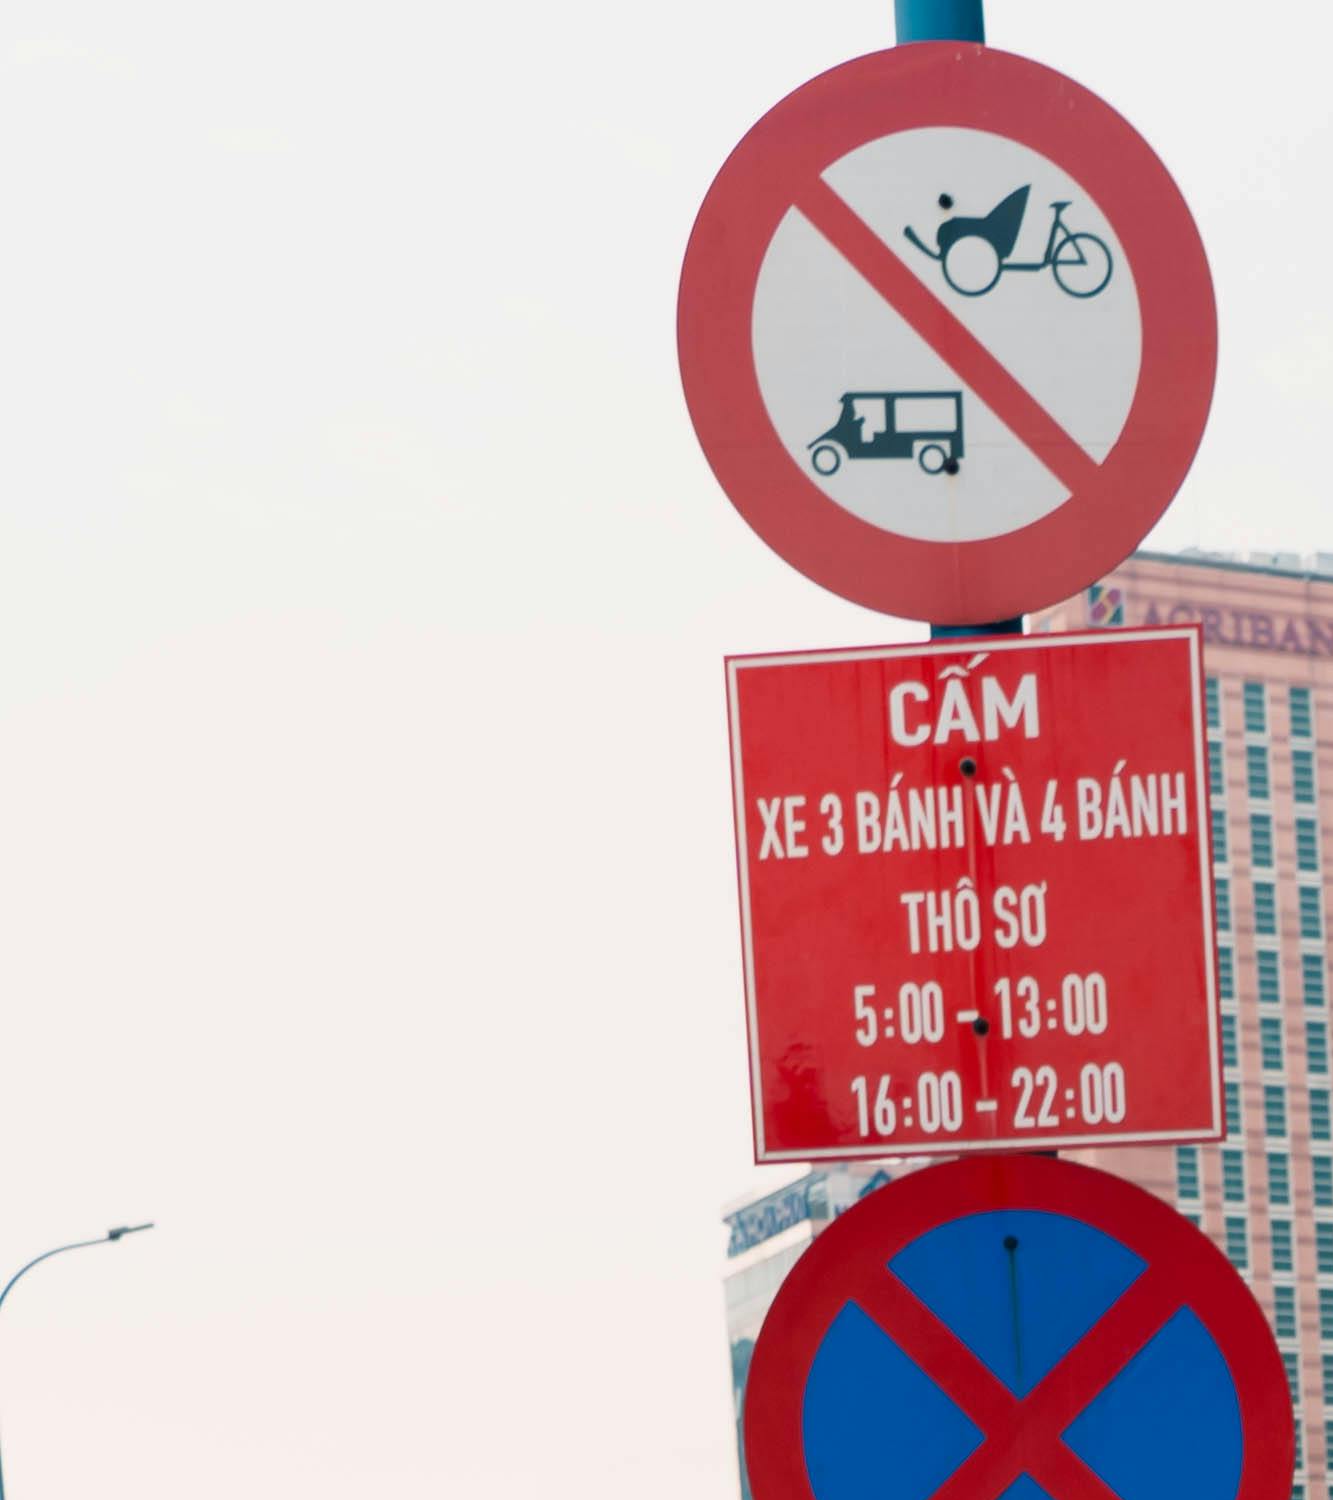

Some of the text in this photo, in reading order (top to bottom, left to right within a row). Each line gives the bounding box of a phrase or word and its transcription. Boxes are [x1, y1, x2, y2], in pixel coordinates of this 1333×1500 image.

[889, 653, 1040, 747] CẤM
[757, 759, 1187, 860] XE 3 BÁNH VÀ 4 BÁNH
[900, 877, 1047, 955] THÔ SƠ
[854, 981, 944, 1047] 5:00
[994, 972, 1108, 1039] 13:00
[851, 1071, 963, 1137] 16:00
[1011, 1062, 1126, 1128] 22:00
